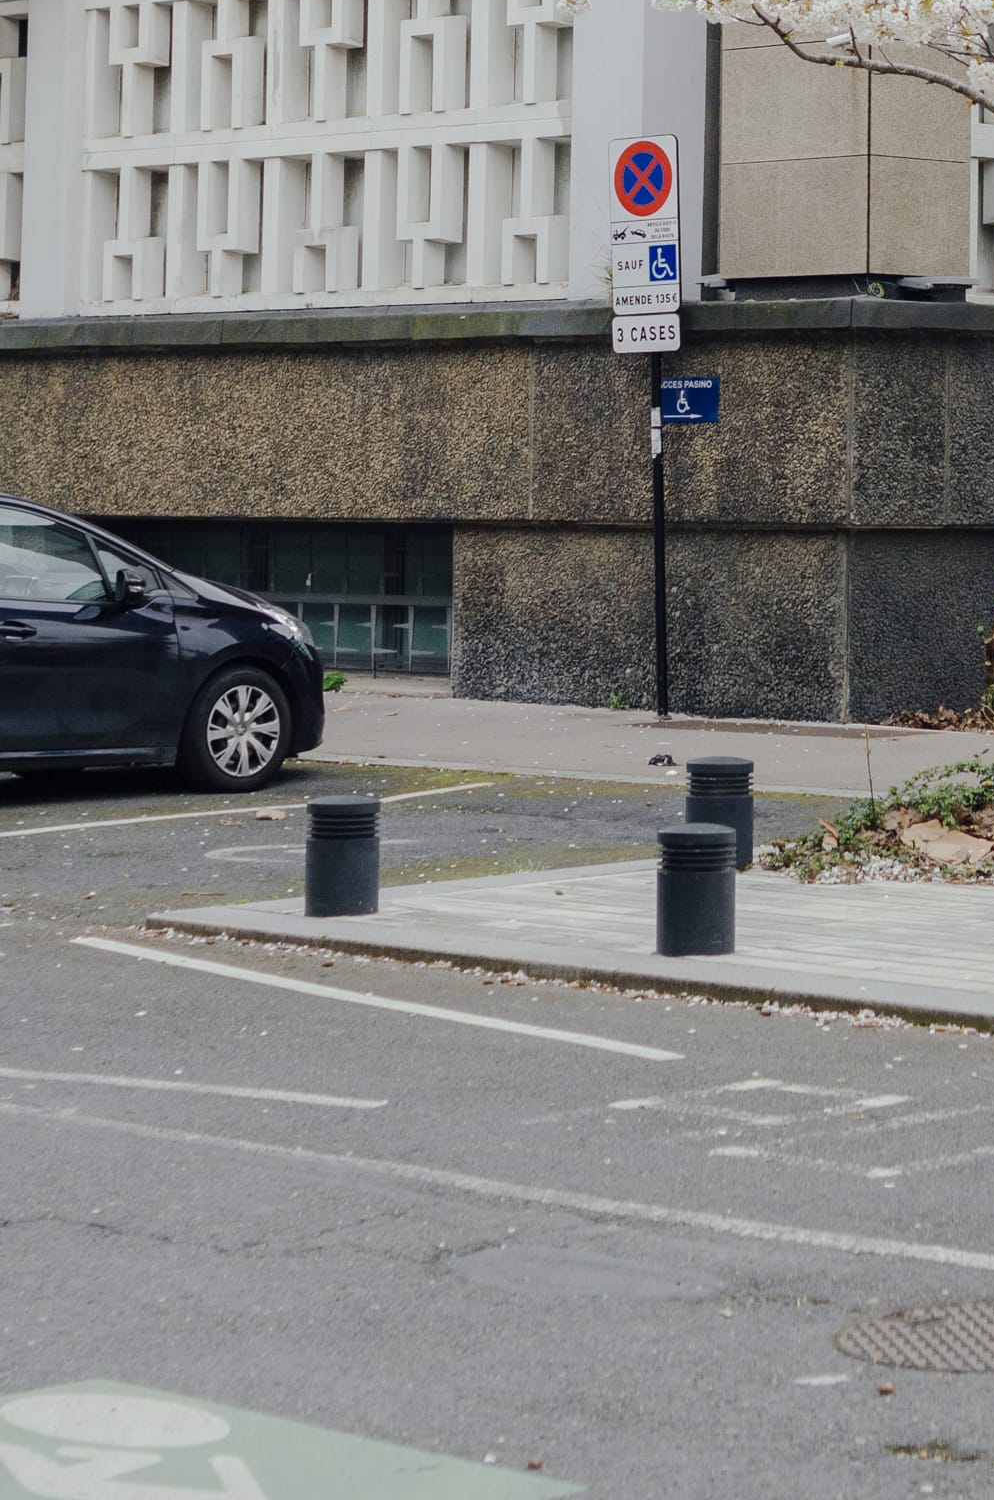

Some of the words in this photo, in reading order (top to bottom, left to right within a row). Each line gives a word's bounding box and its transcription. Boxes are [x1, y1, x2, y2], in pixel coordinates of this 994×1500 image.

[617, 260, 644, 271] SAUF
[616, 294, 652, 307] AMENDE
[617, 328, 624, 342] 3
[631, 325, 675, 341] CASES
[661, 380, 683, 389] CCES
[684, 380, 713, 389] PASINO
